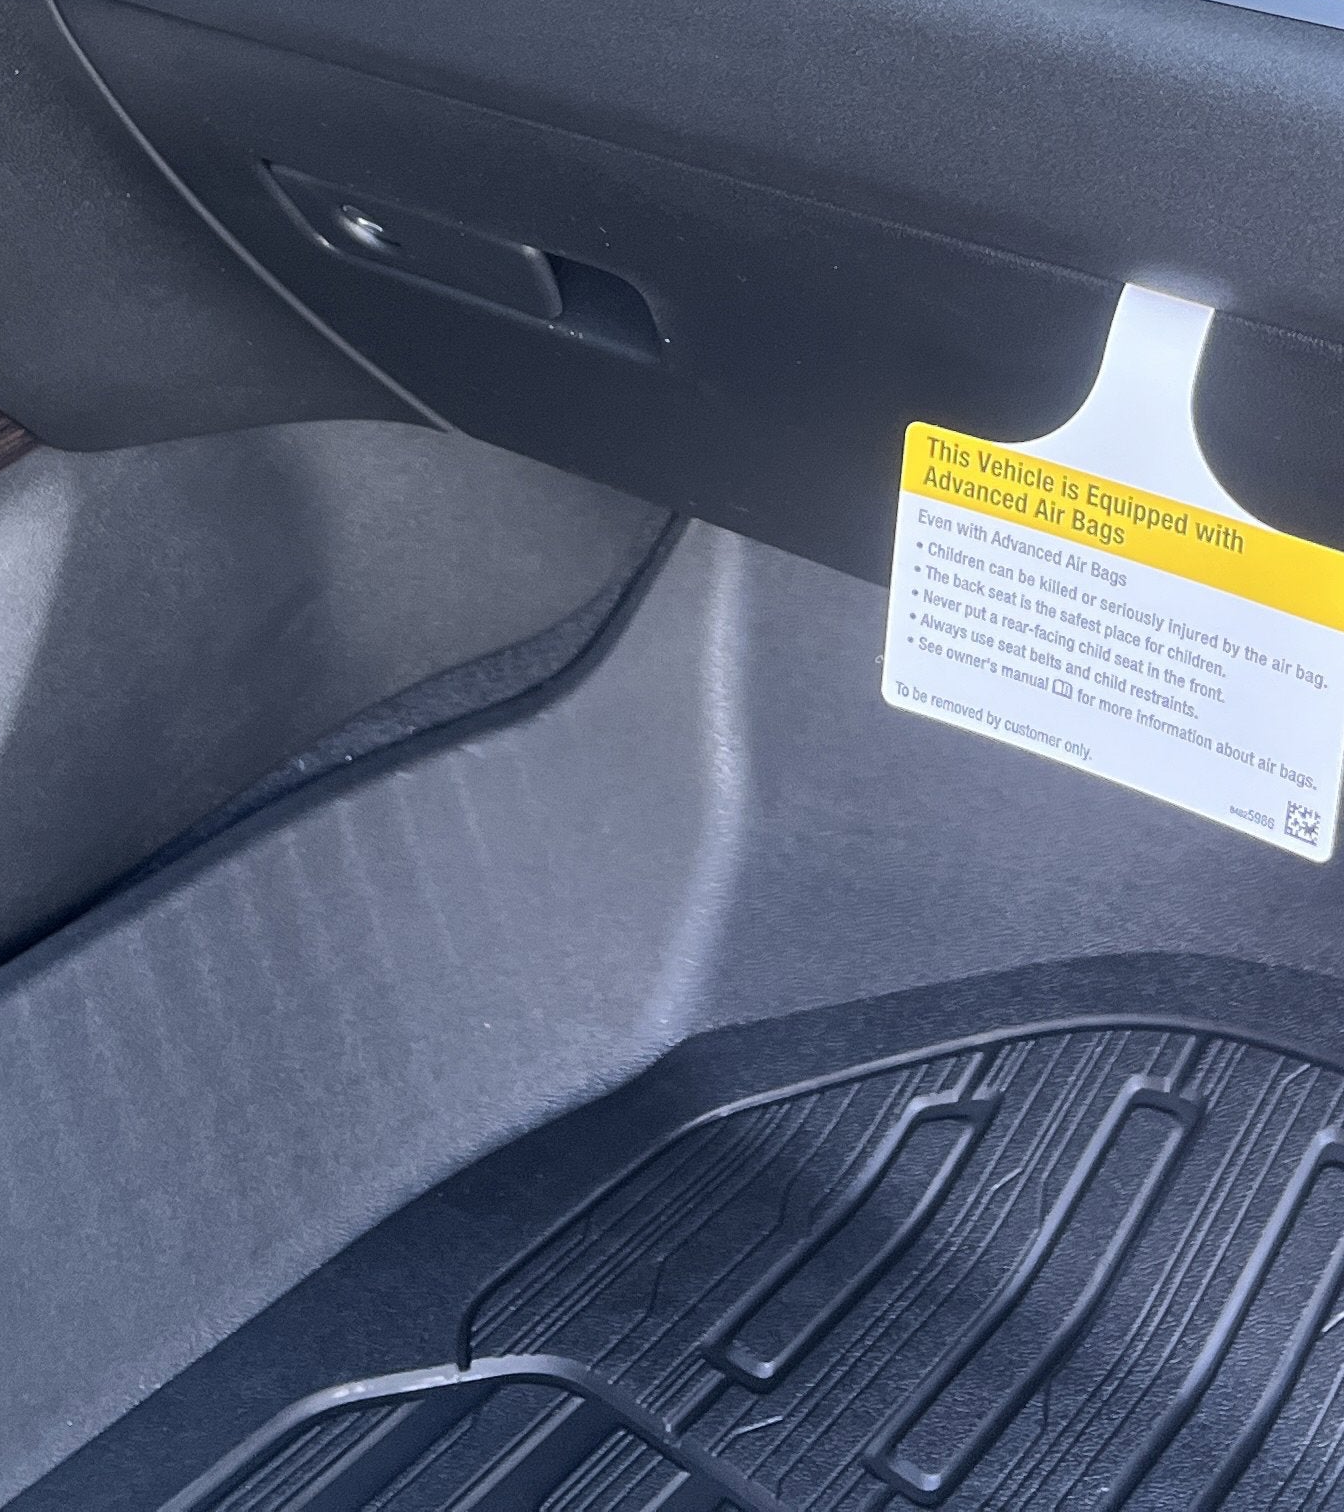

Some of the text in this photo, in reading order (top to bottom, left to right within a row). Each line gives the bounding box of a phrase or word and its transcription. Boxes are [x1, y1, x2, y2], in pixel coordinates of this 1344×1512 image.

[918, 508, 1128, 587] Even with Advanced Air Bags
[922, 465, 1125, 546] Advanced Air Bags
[926, 436, 1244, 554] This Vehicle is Equipped with
[919, 613, 1199, 720] Always use seat belts and child restraints.
[922, 588, 1225, 704] Never put a rear-facing child seat in the front.
[925, 564, 1226, 678] The back seat is the safest place for children.
[927, 541, 1328, 690] Children can be killed or seriously injured by the air bag.
[895, 680, 1093, 761] To be removed by customer only.
[918, 636, 1318, 791] See owner's manual for more information about air bags.
